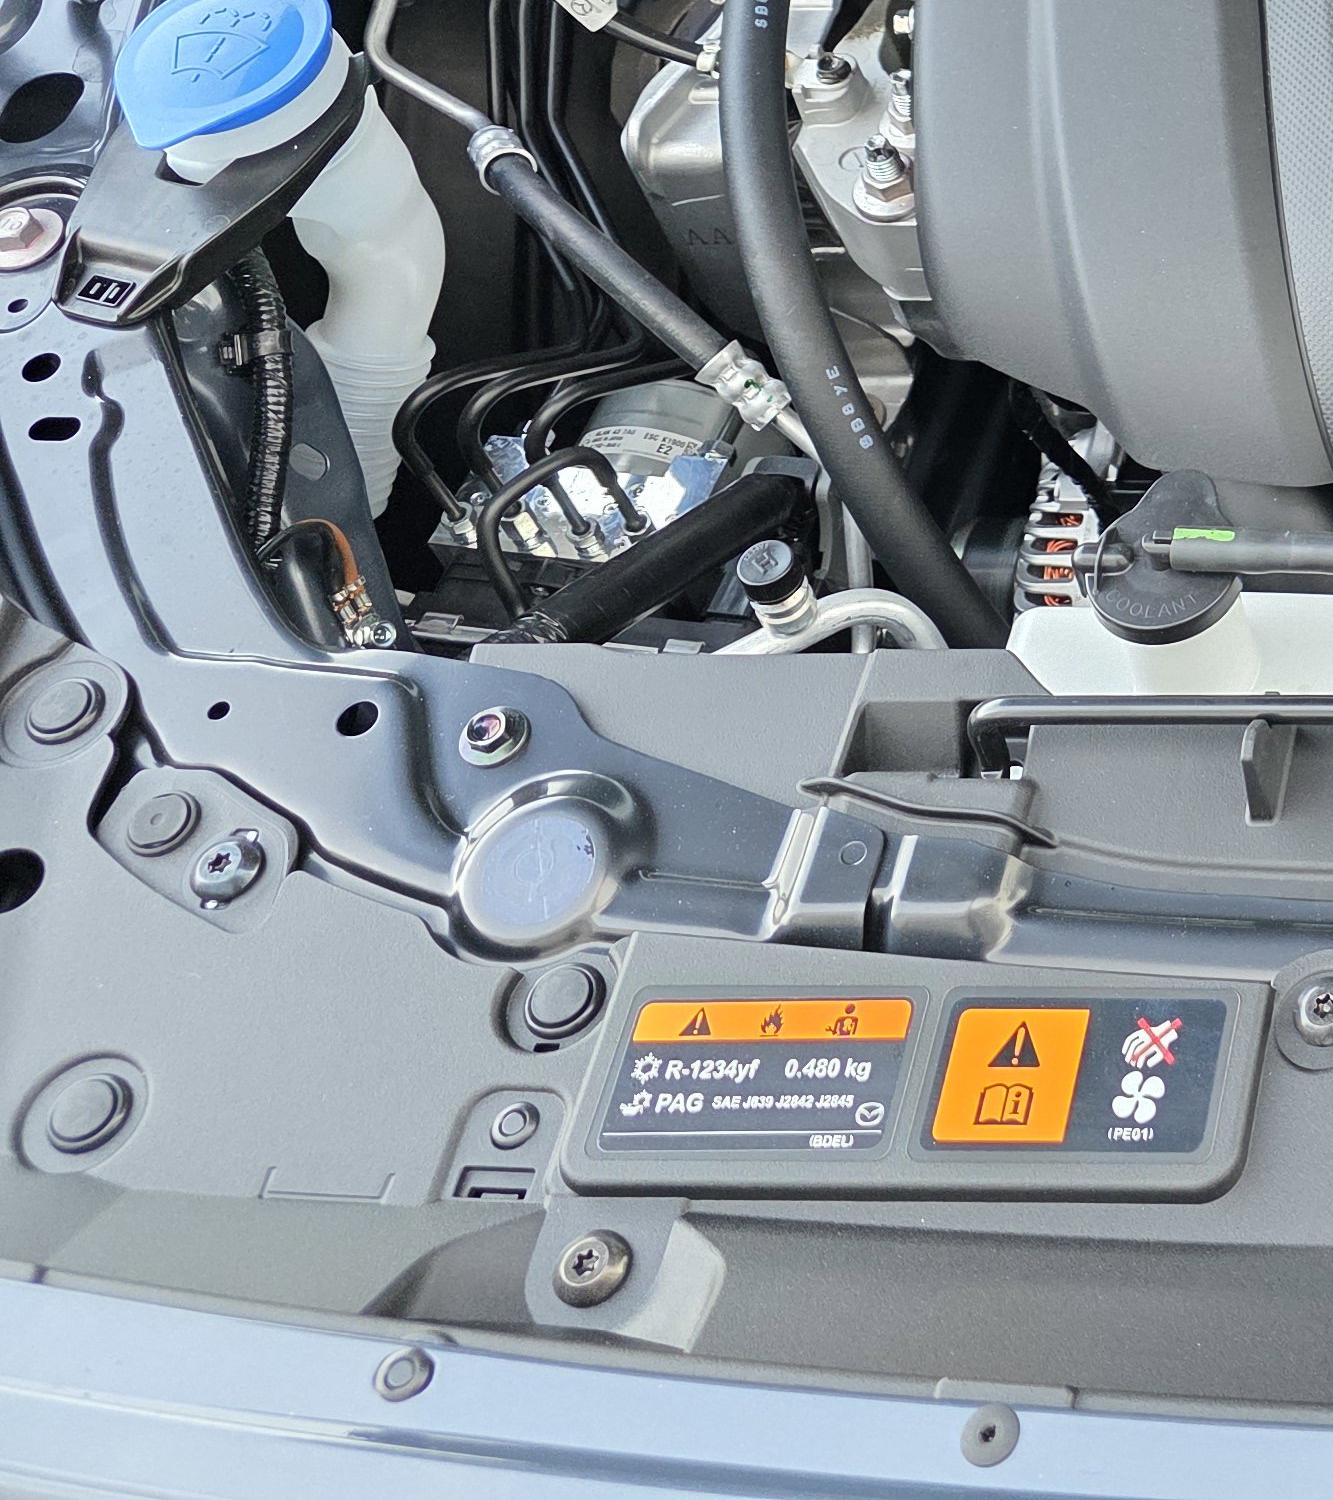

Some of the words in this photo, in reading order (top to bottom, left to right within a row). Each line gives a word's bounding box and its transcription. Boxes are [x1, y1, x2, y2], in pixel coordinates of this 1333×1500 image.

[656, 443, 673, 456] E2
[1105, 588, 1198, 619] COOLANT
[663, 1057, 760, 1082] R-1234yf
[783, 1056, 841, 1080] 0.480
[845, 1057, 872, 1082] kg
[654, 1093, 704, 1113] PAG
[711, 1095, 741, 1110] SAE
